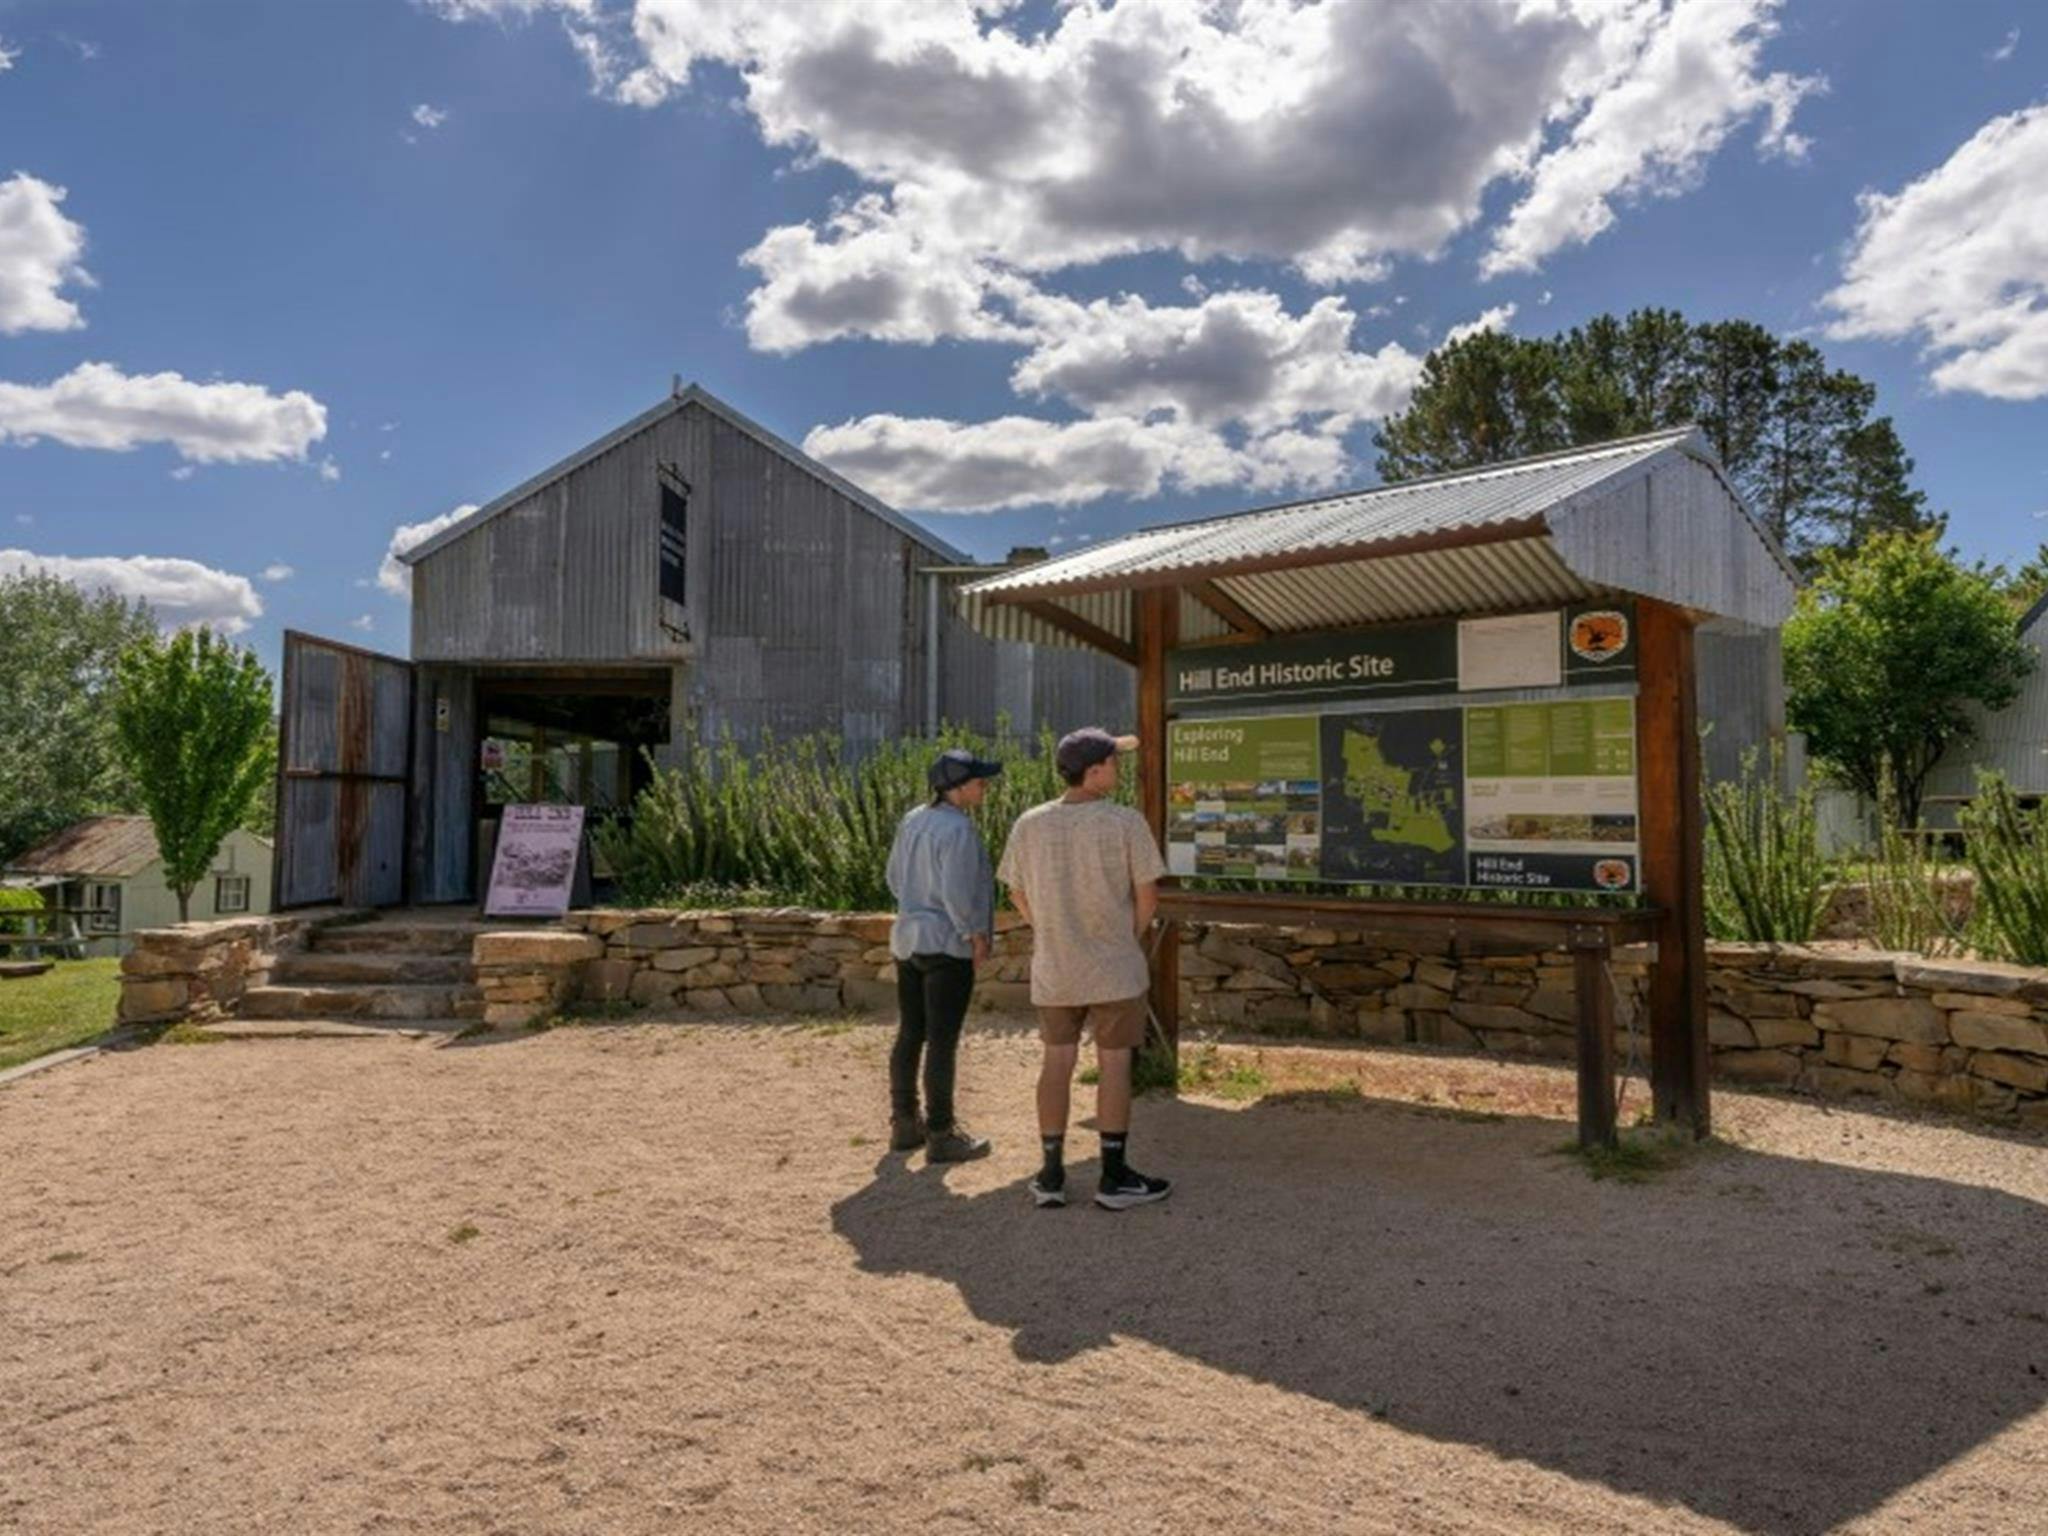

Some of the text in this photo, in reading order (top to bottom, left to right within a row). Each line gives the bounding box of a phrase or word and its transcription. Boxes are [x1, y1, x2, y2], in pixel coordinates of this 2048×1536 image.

[1179, 654, 1395, 691] Hill End Historic Site
[1174, 726, 1244, 744] Exploring
[1174, 747, 1230, 763] Hill End
[1476, 857, 1524, 872] Hill End
[1476, 871, 1551, 885] Historic Site
